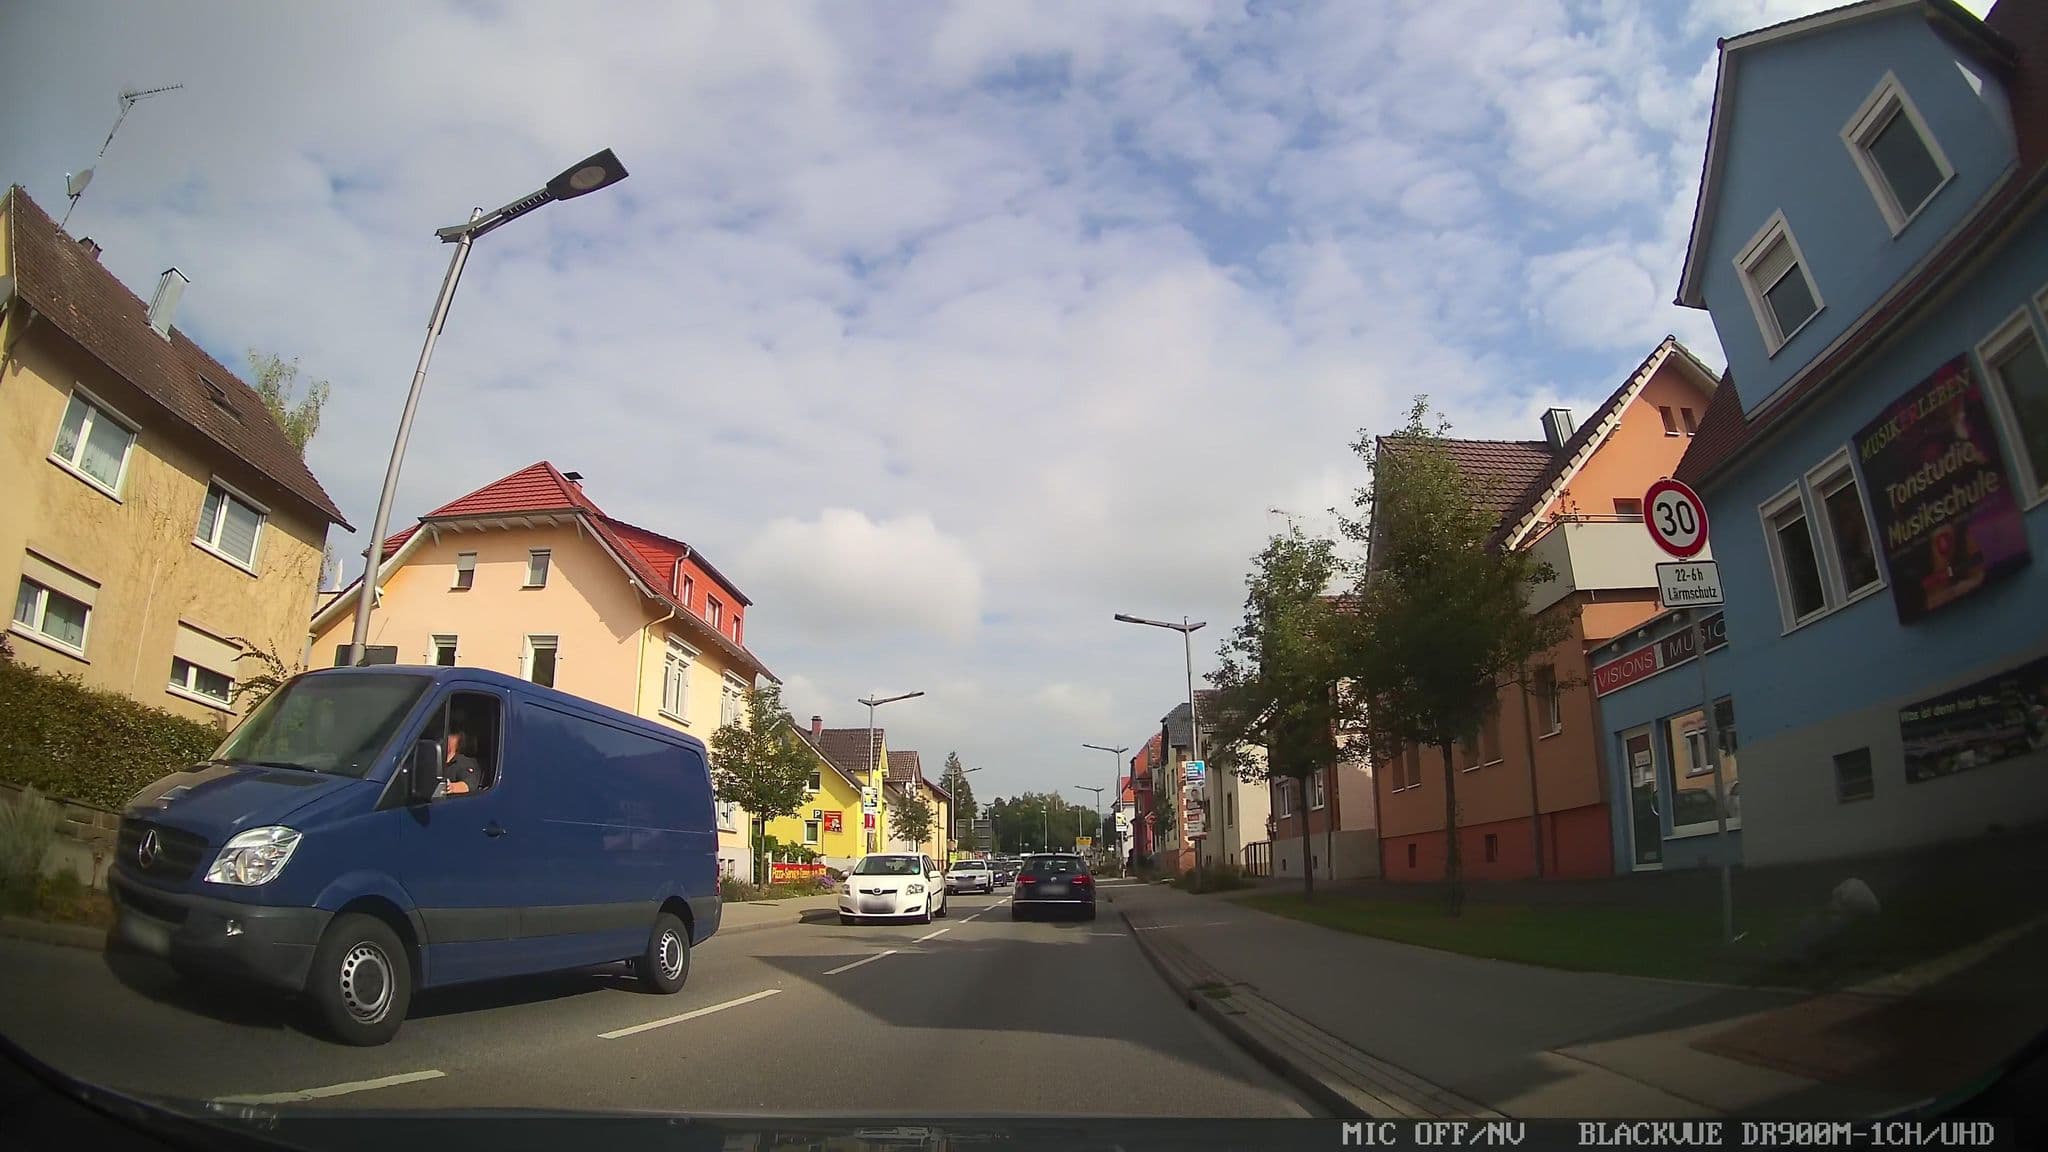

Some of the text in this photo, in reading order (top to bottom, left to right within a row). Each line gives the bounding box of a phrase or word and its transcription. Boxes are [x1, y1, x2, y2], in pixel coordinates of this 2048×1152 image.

[1886, 439, 1977, 510] Tonstudio
[1656, 500, 1696, 536] 30
[1888, 469, 2001, 549] Musikschule
[1667, 585, 1718, 601] Lärmschutz
[1597, 652, 1653, 688] VISIONS
